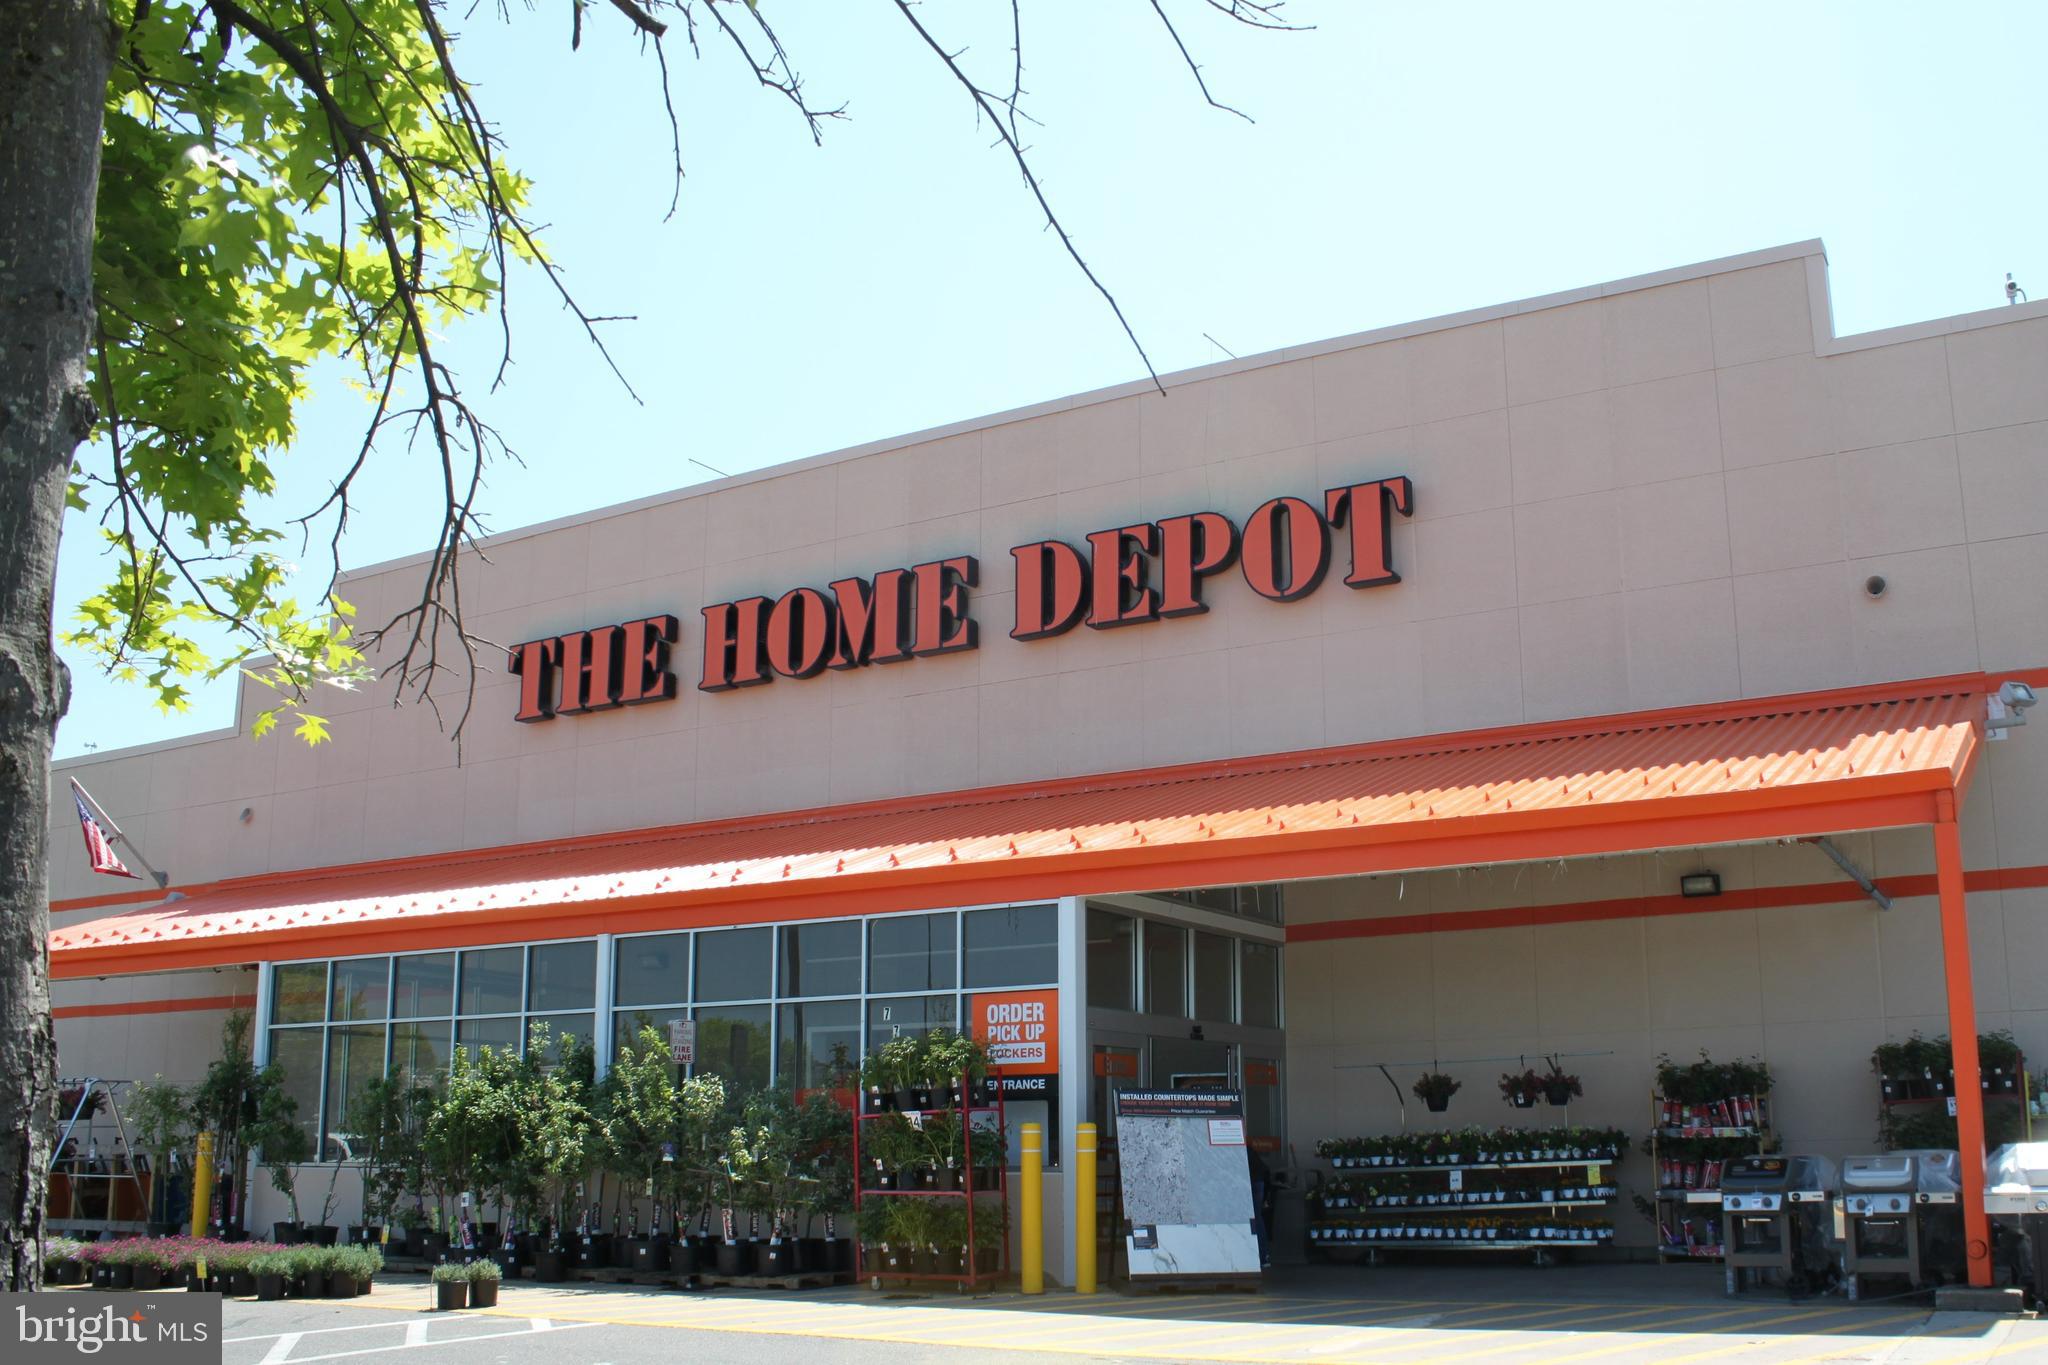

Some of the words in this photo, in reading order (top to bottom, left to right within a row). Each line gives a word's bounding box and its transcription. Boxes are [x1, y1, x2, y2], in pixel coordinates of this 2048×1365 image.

[509, 614, 678, 723] THE
[698, 556, 978, 693] HOME
[1009, 476, 1412, 642] DEPOT
[987, 1002, 1045, 1024] ORDER
[987, 1024, 1021, 1041] PICK
[1025, 1023, 1045, 1040] UP
[673, 1045, 691, 1054] FIRE
[987, 1079, 1045, 1090] ENTRANCE
